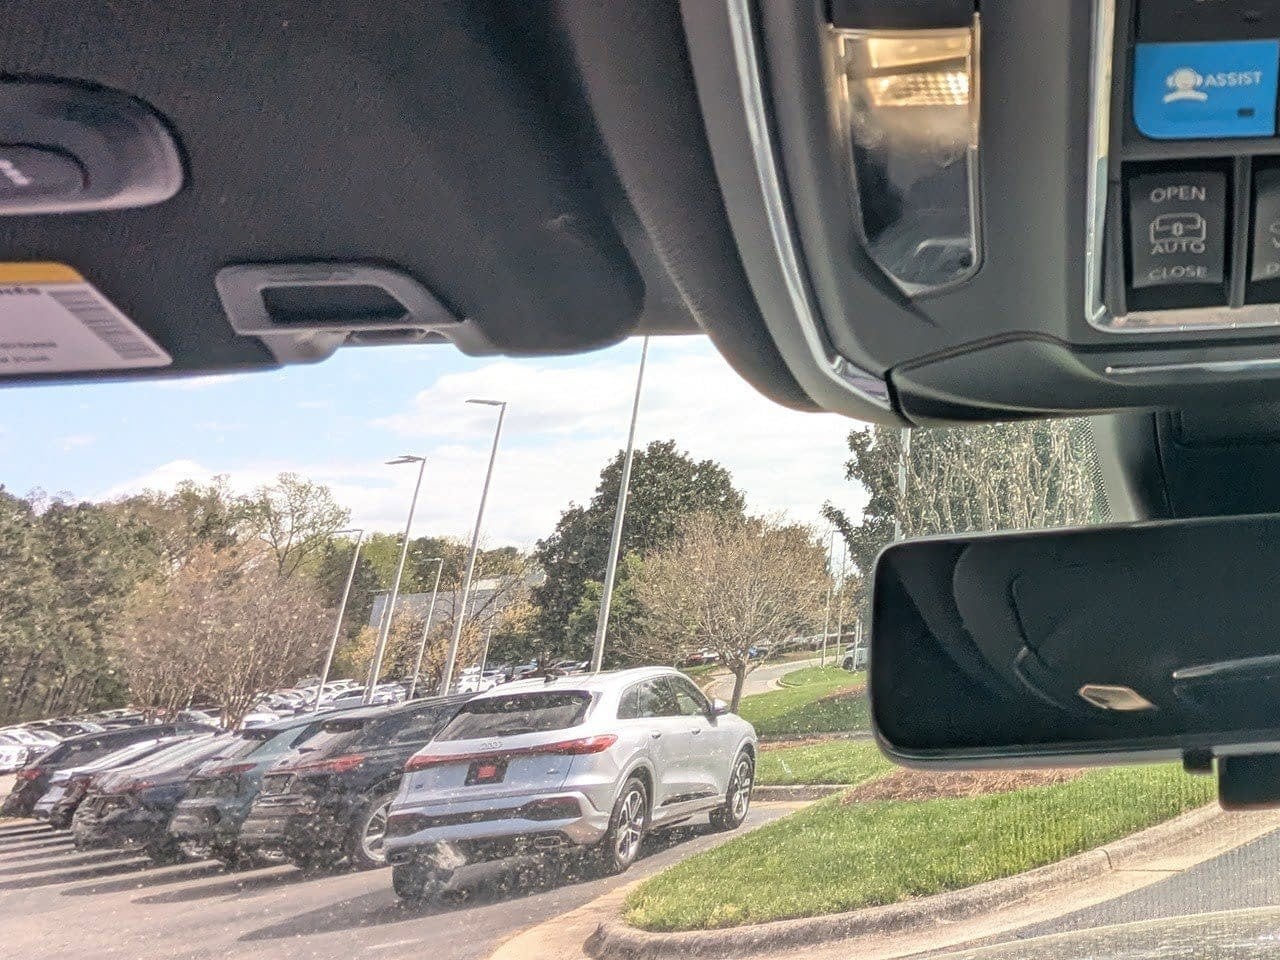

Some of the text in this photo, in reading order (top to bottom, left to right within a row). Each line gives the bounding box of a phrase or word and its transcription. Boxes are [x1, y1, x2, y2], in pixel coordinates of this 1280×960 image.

[1205, 70, 1263, 87] ASSIST
[1151, 185, 1207, 203] OPEN
[1151, 240, 1206, 255] AUTO
[1149, 265, 1208, 281] CLOSE
